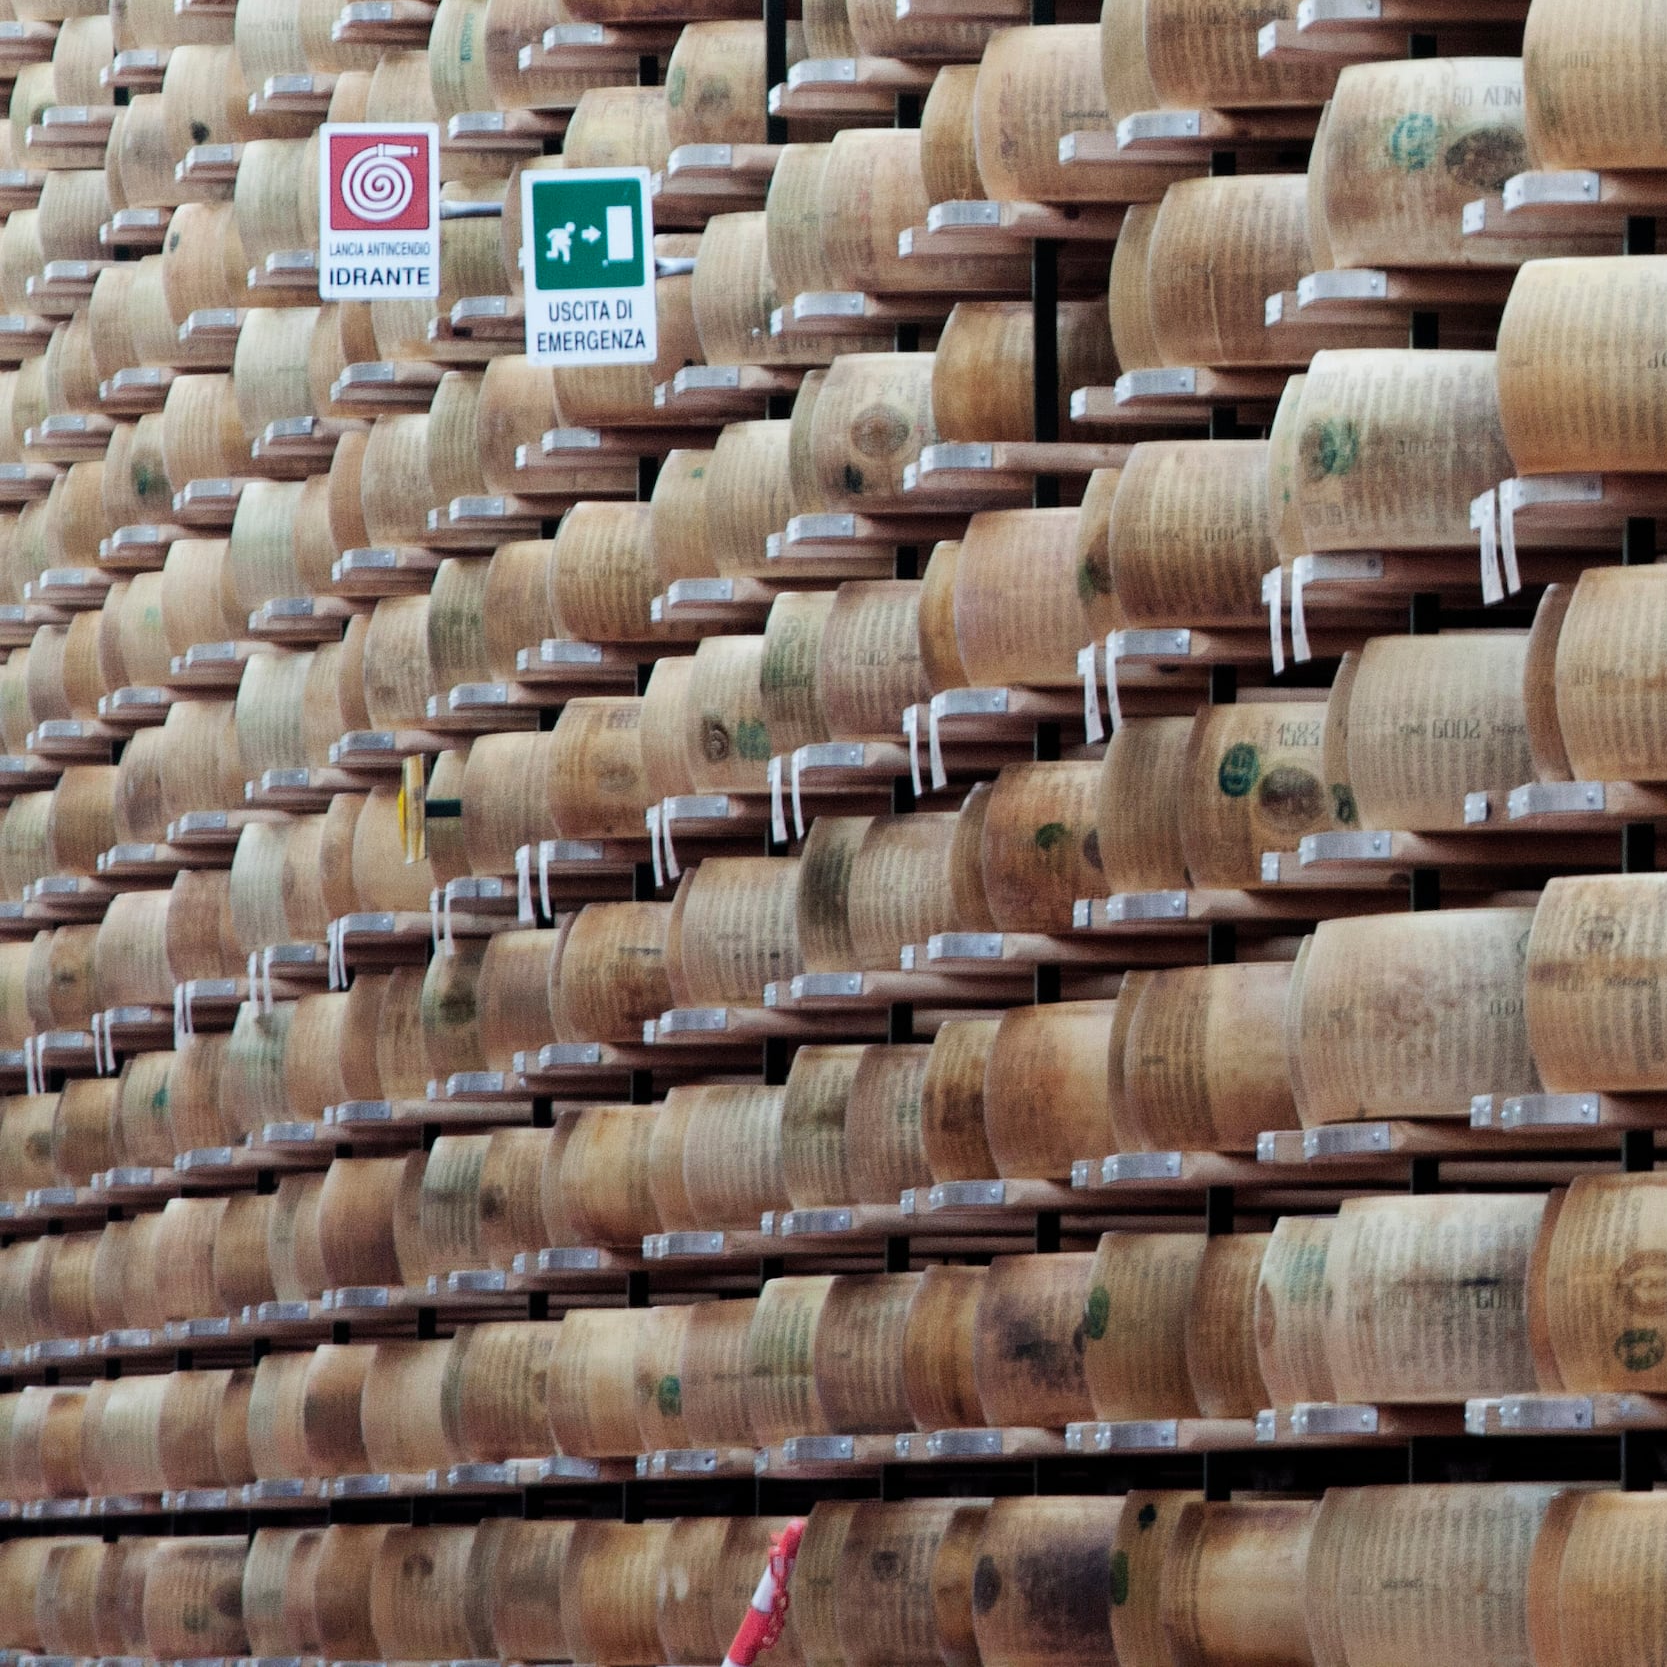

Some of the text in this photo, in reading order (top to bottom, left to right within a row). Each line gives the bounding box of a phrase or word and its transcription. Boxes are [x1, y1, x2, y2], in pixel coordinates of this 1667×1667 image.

[329, 240, 431, 257] LANCIA ANTINCENDIO
[329, 267, 431, 286] IDRANTE
[548, 299, 632, 322] USCITA DI
[536, 331, 646, 353] EMERGENZA
